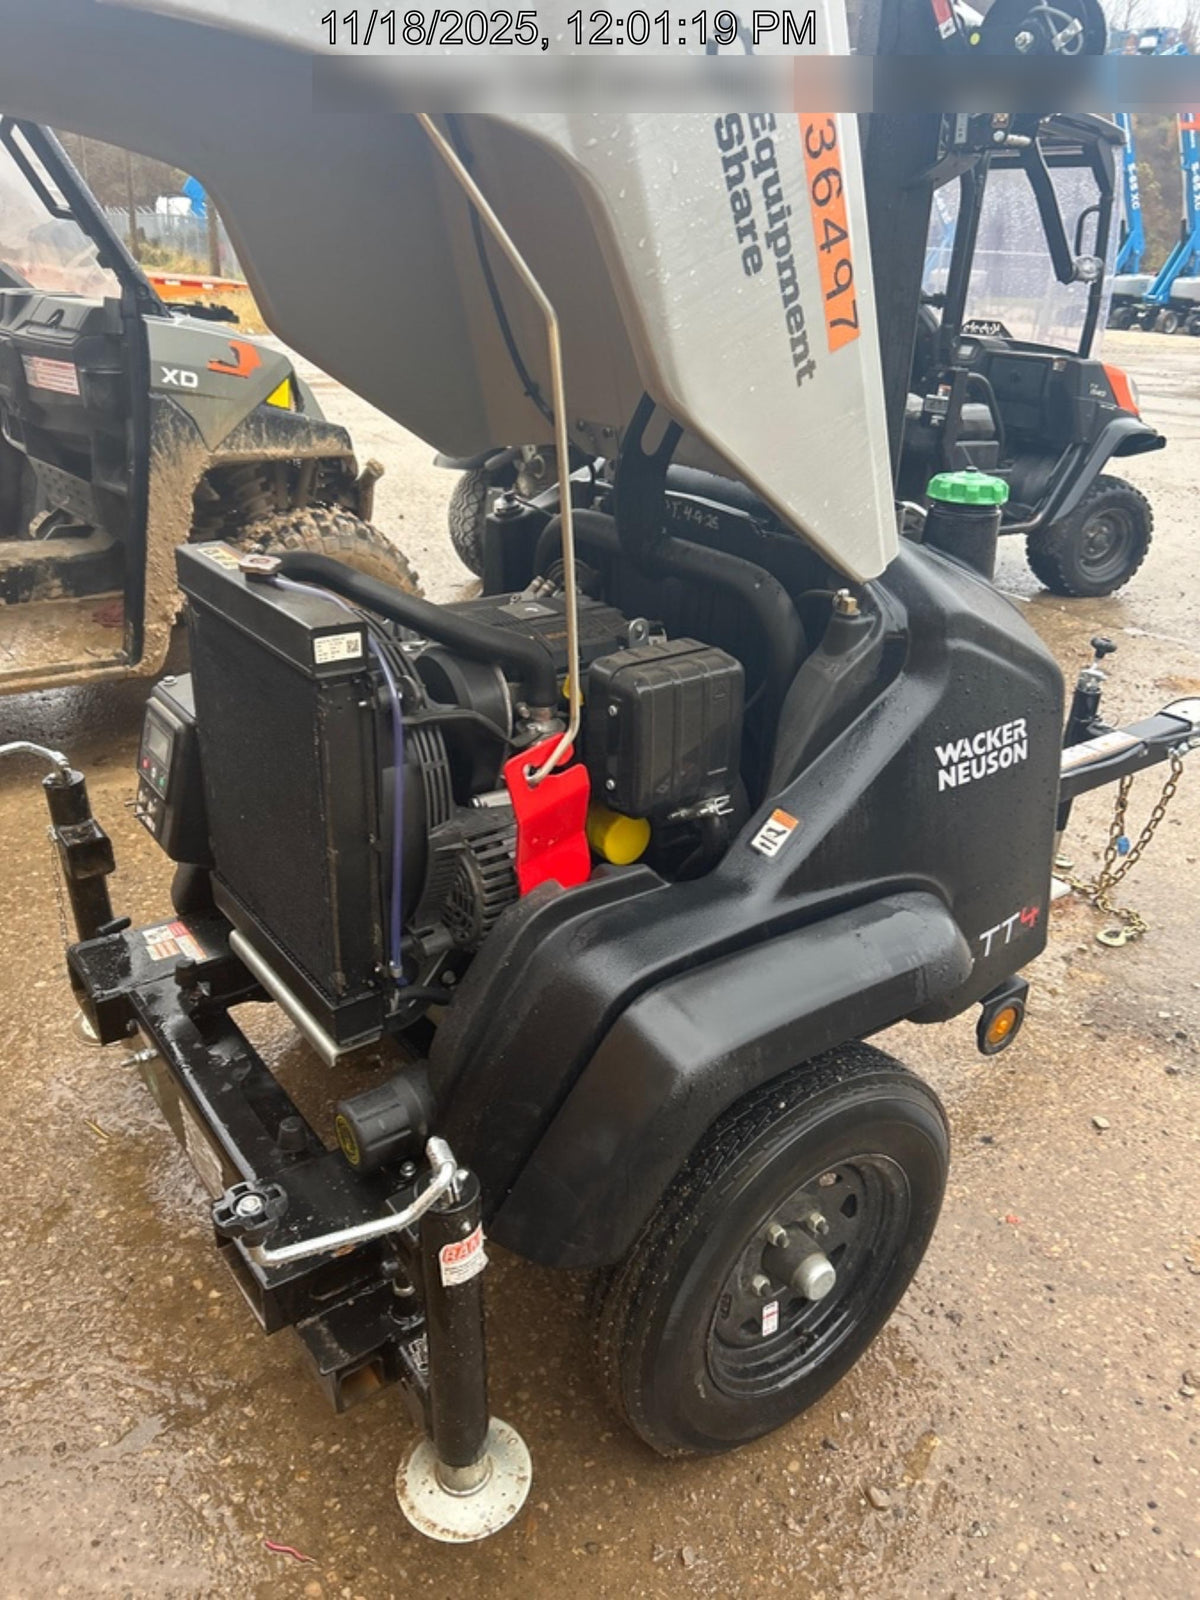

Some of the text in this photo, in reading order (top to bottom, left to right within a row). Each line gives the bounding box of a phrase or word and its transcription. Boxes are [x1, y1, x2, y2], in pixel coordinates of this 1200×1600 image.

[714, 113, 763, 278] Share
[747, 113, 817, 388] Equipment
[160, 366, 198, 388] XD
[935, 718, 1028, 767] WACKER
[938, 739, 1028, 792] NEUSON
